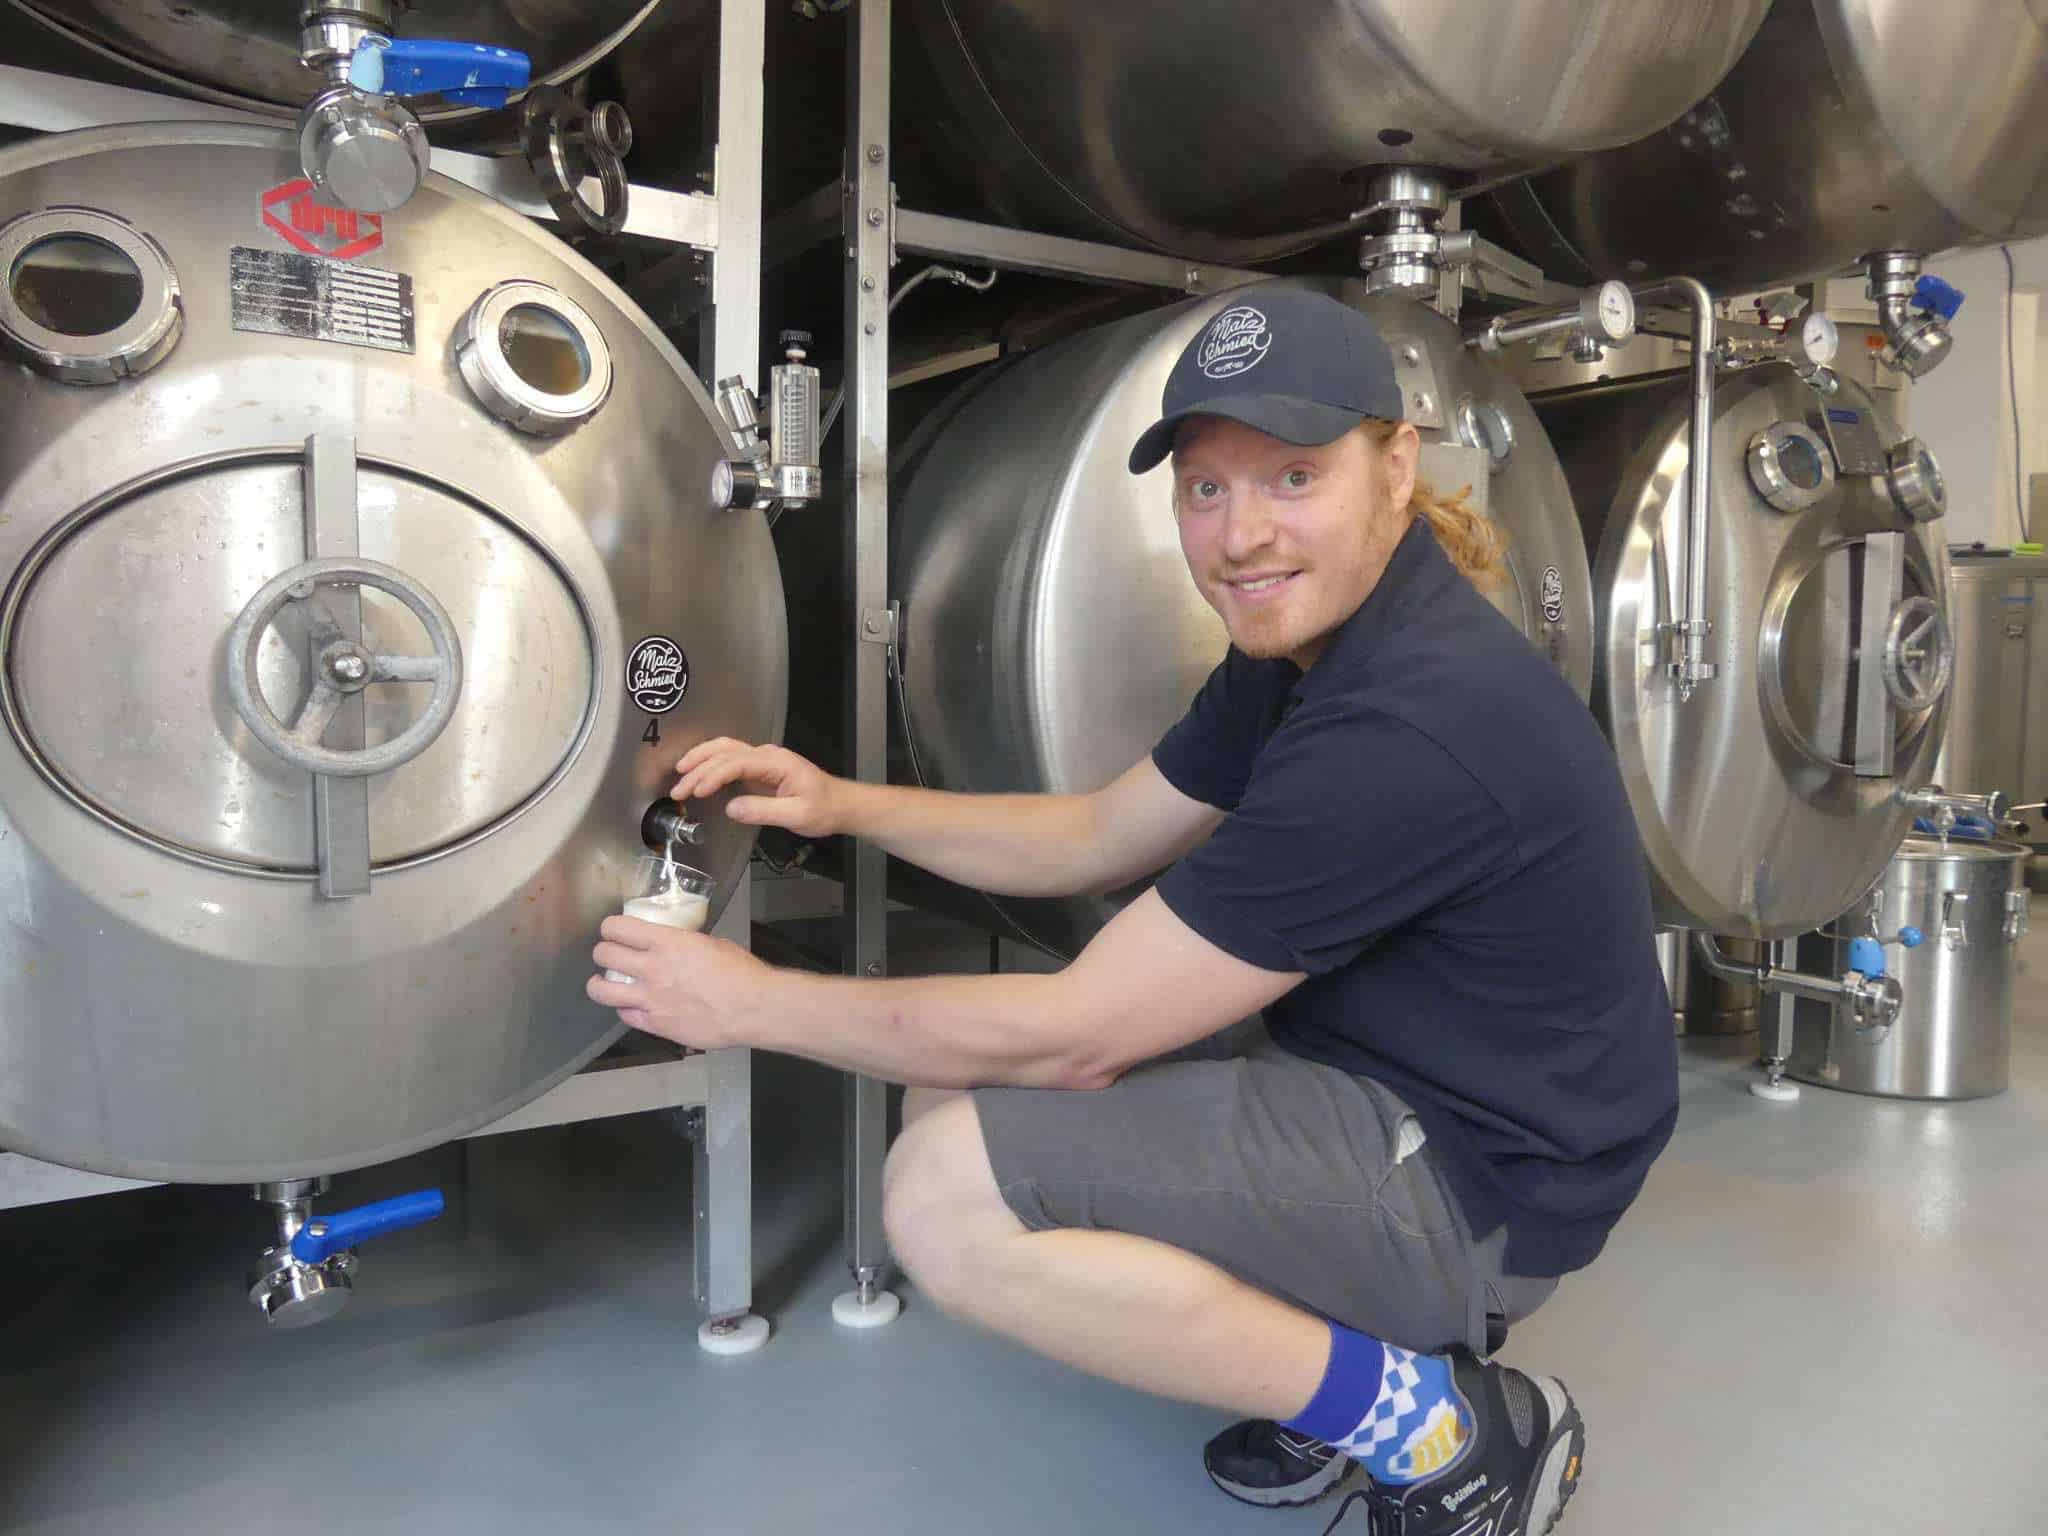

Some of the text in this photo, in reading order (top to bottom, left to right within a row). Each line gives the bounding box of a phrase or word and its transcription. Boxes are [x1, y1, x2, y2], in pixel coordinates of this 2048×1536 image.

[1211, 312, 1261, 341] Malz
[638, 646, 681, 672] Malz
[634, 669, 684, 690] Schmied
[642, 718, 661, 746] 4
